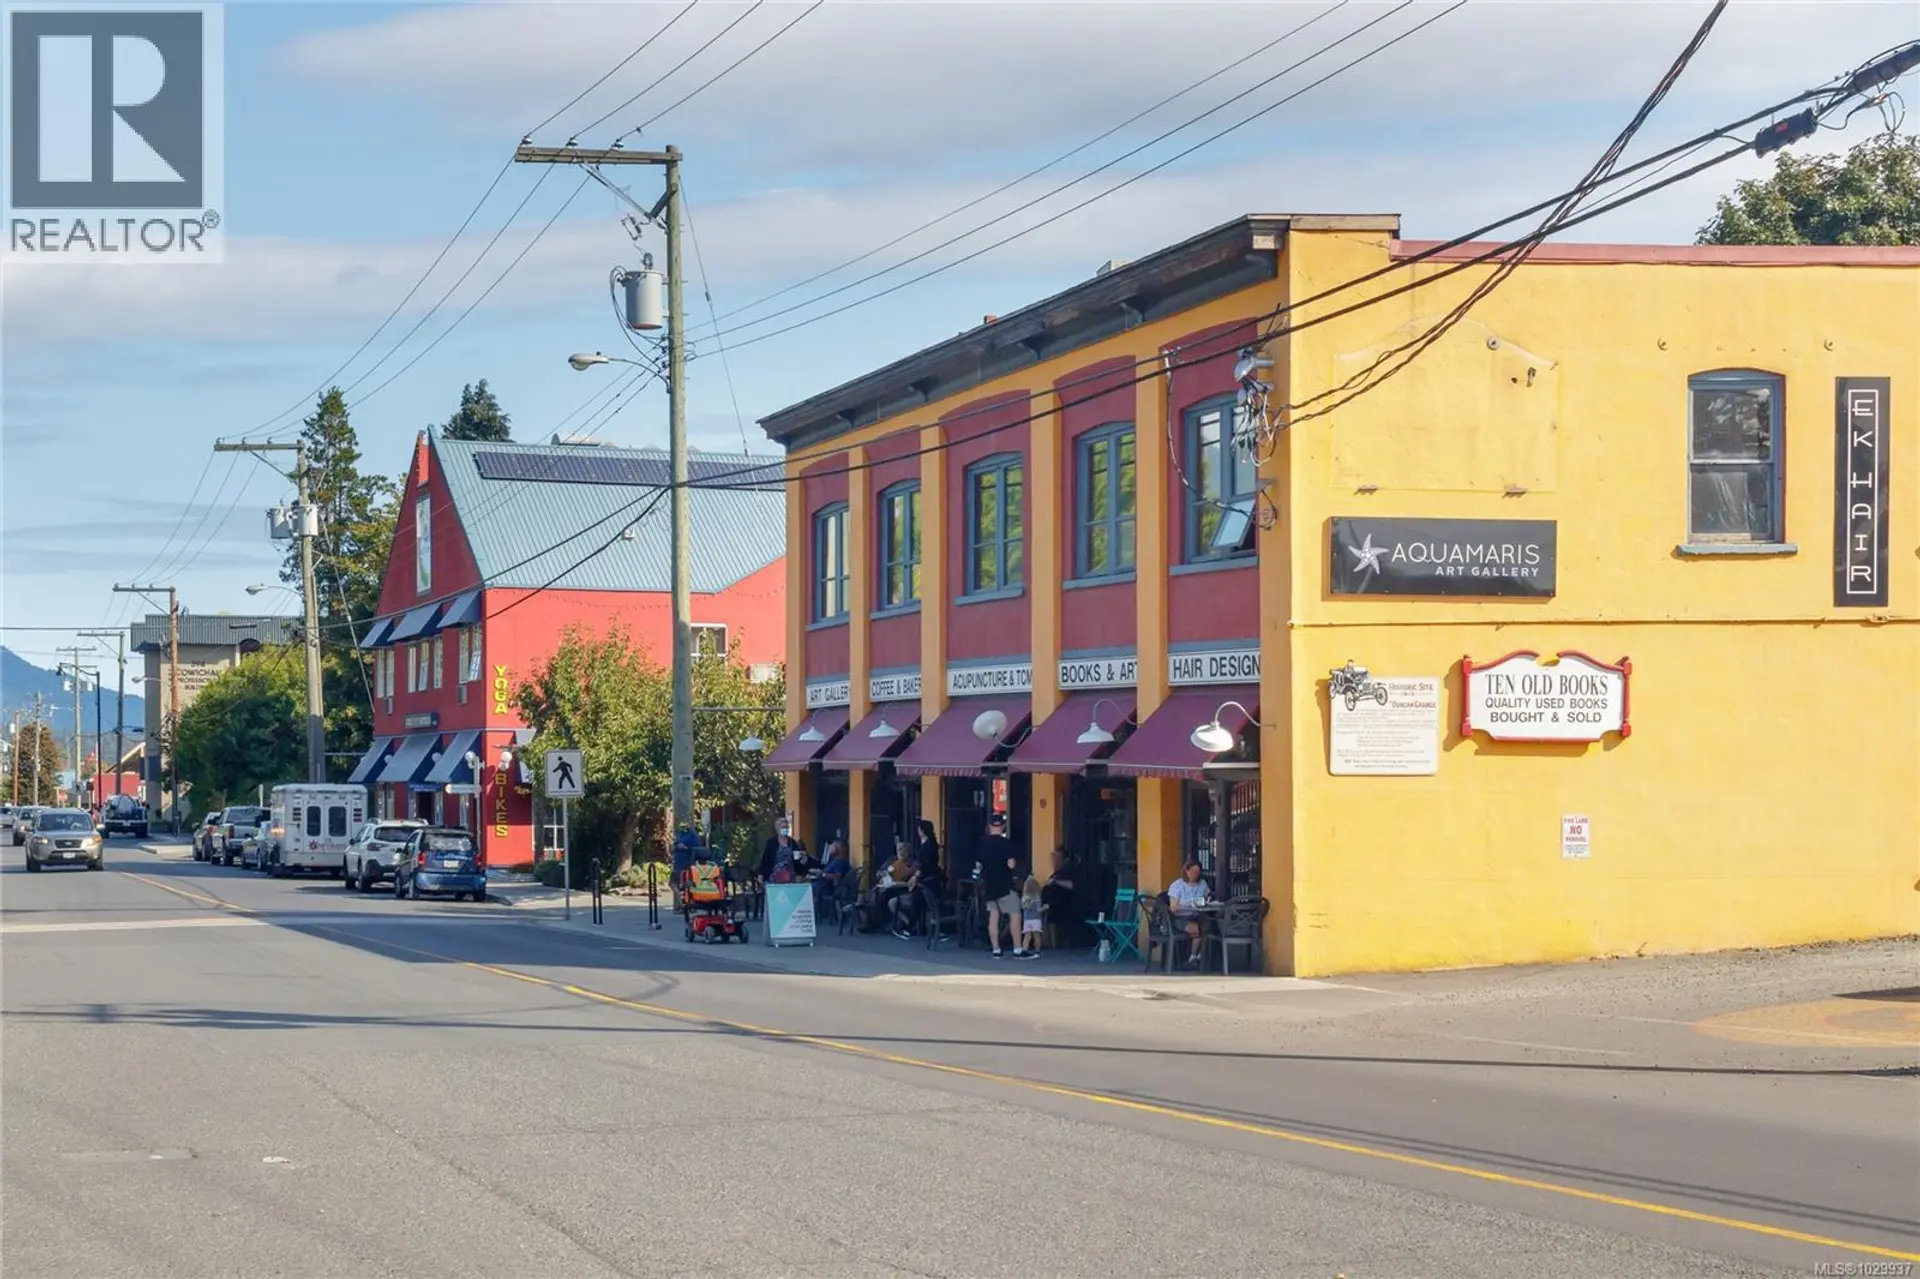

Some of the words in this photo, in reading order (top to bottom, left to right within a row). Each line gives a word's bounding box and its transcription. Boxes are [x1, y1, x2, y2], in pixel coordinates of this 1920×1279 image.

[1392, 543, 1540, 564] AQUAMARIS
[1436, 566, 1464, 576] ART
[1471, 566, 1540, 577] GALLERY
[1061, 663, 1101, 683] BOOKS
[1107, 663, 1114, 681] &
[1173, 657, 1203, 679] HAIR
[1209, 654, 1260, 677] DESIGN
[494, 664, 508, 714] YOGA
[872, 680, 894, 696] COFFEE
[896, 679, 902, 694] &
[953, 670, 1008, 689] ACUPUNCTURE
[1010, 669, 1014, 686] &
[1485, 674, 1515, 695] TEN
[1521, 674, 1552, 695] OLD
[1559, 674, 1608, 695] BOOKS
[810, 688, 821, 702] ART
[825, 684, 850, 701] GALLER
[1485, 697, 1531, 709] QUALITY
[1535, 698, 1565, 709] USED
[1570, 698, 1608, 709] BOOKS
[1490, 712, 1544, 723] BOUGHT
[1551, 712, 1559, 723] &
[1567, 712, 1602, 723] SOLD
[495, 773, 508, 837] BIKES
[1570, 825, 1582, 835] NO
